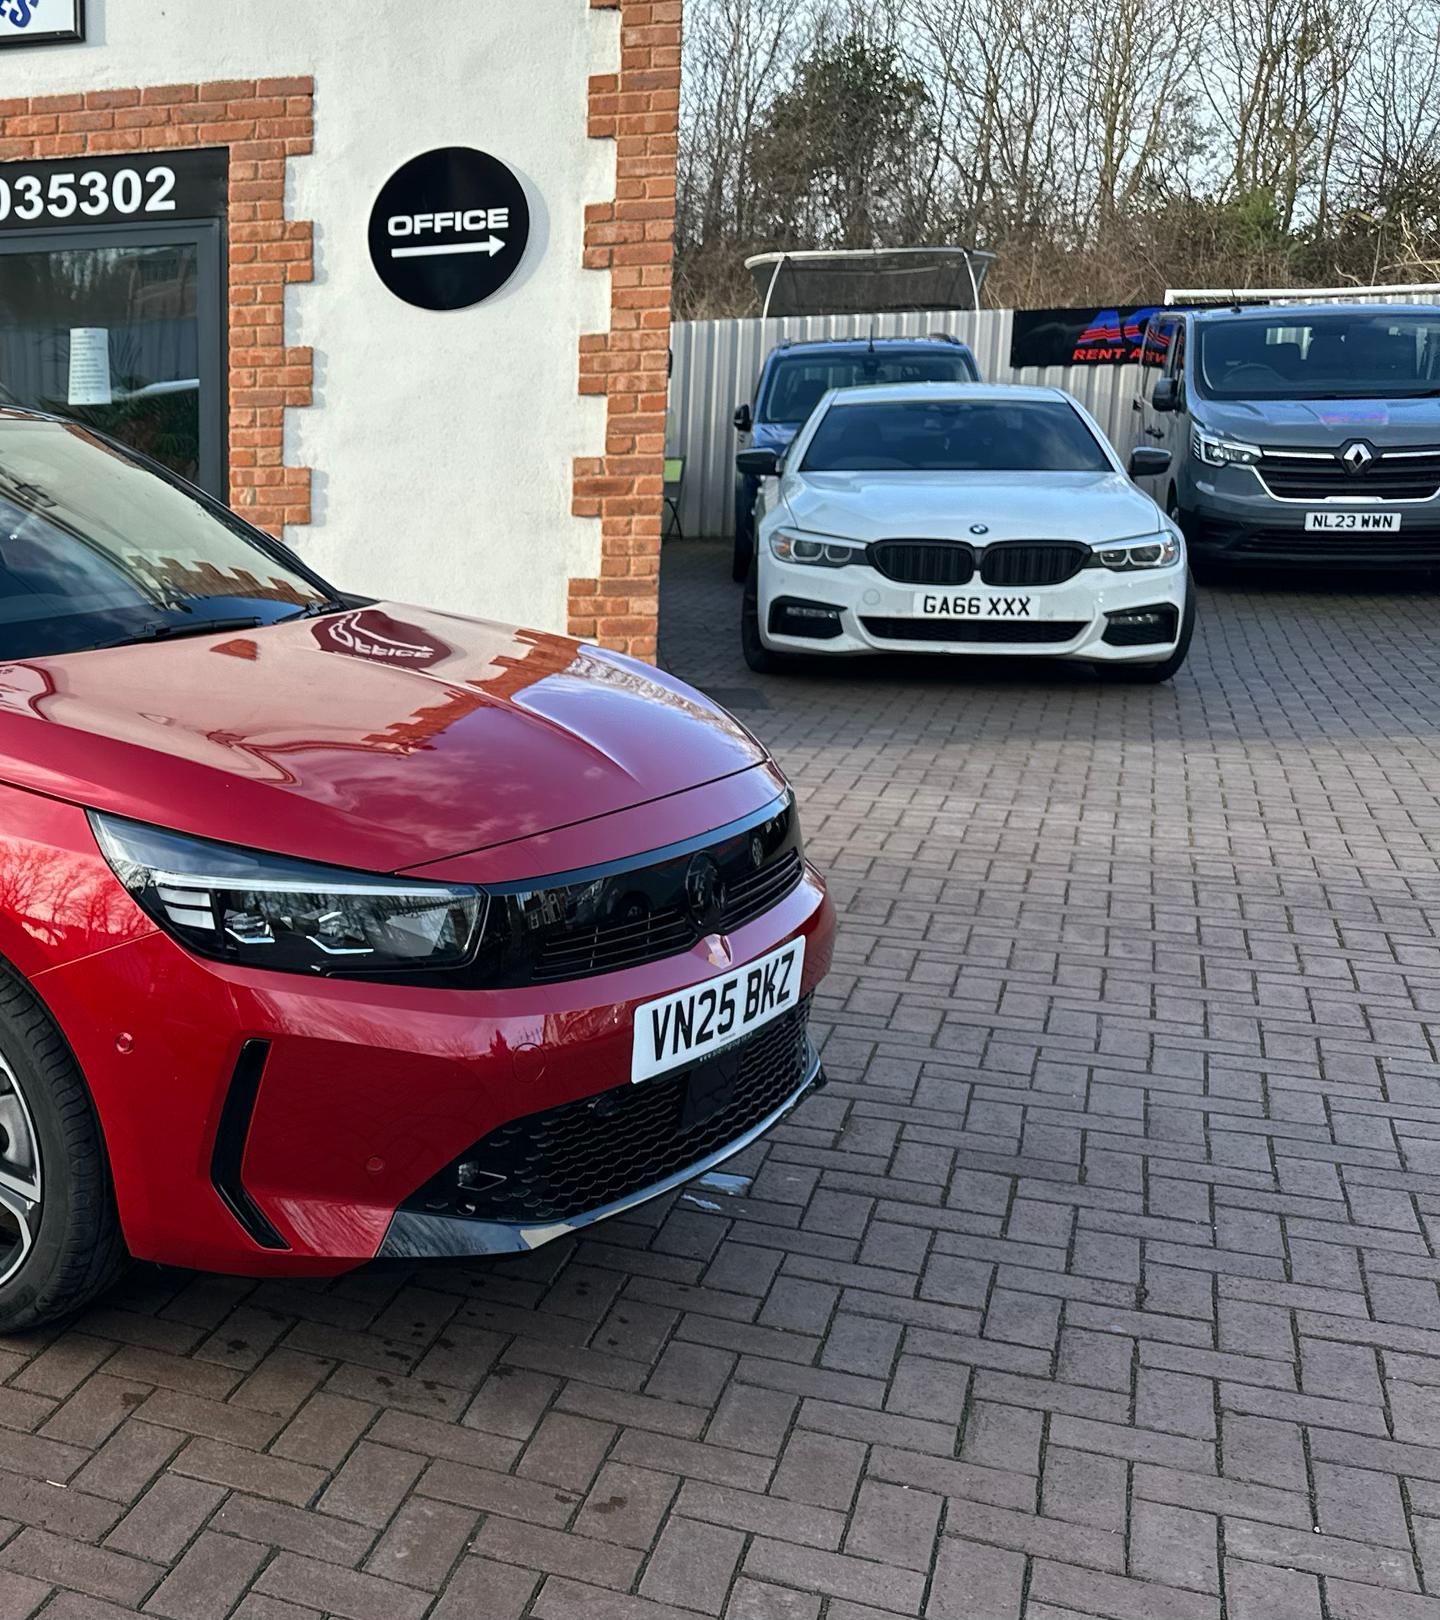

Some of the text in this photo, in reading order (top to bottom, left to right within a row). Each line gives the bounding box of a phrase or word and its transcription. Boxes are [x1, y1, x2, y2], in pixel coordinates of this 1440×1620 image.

[387, 207, 509, 236] OFFICE
[1072, 348, 1126, 360] RENT
[1312, 514, 1393, 528] NL23 WWN
[923, 595, 1031, 615] GA66 XXX
[652, 950, 795, 1062] VN25 BKZ
